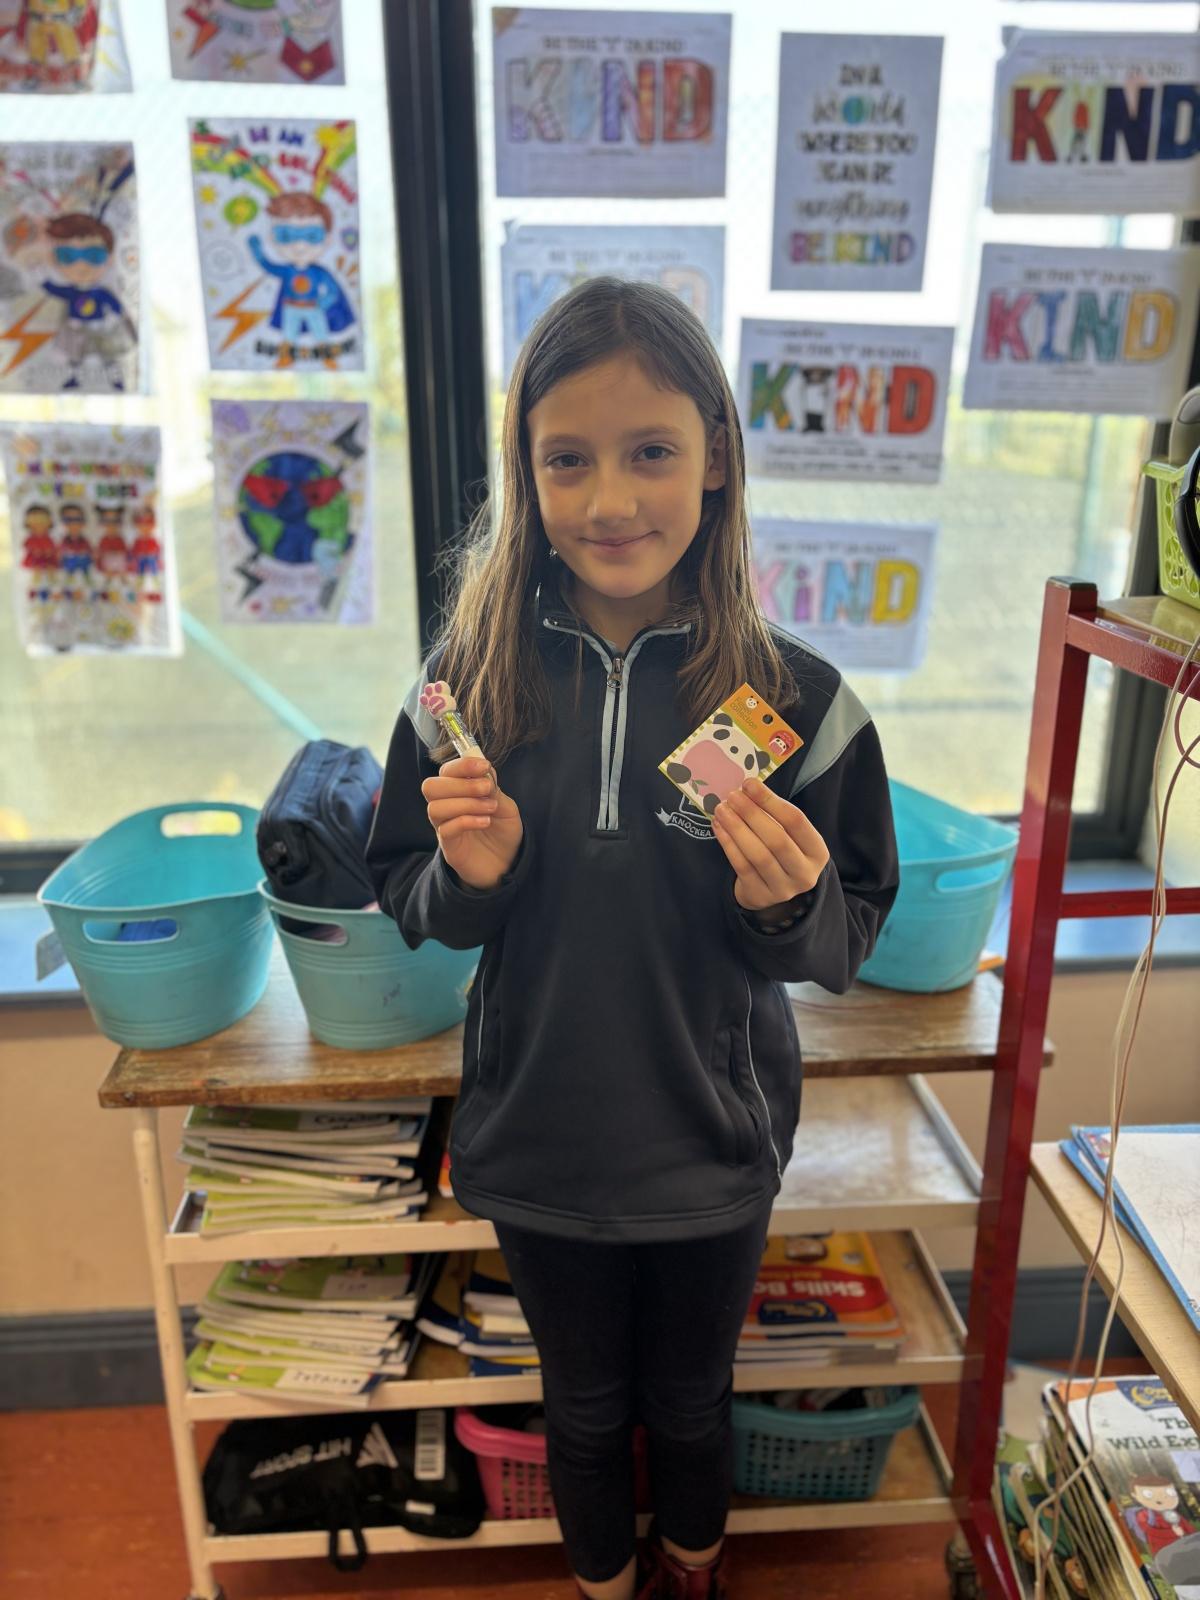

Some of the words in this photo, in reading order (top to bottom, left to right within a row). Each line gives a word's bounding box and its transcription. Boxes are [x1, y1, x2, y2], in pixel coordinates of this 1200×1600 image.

[789, 230, 826, 264] BE
[833, 231, 916, 265] KIND
[982, 288, 1178, 364] KIND
[791, 1279, 867, 1298] Skills
[1158, 1416, 1191, 1431] Th
[1107, 1435, 1162, 1451] Wild
[1164, 1434, 1200, 1450] Ex
